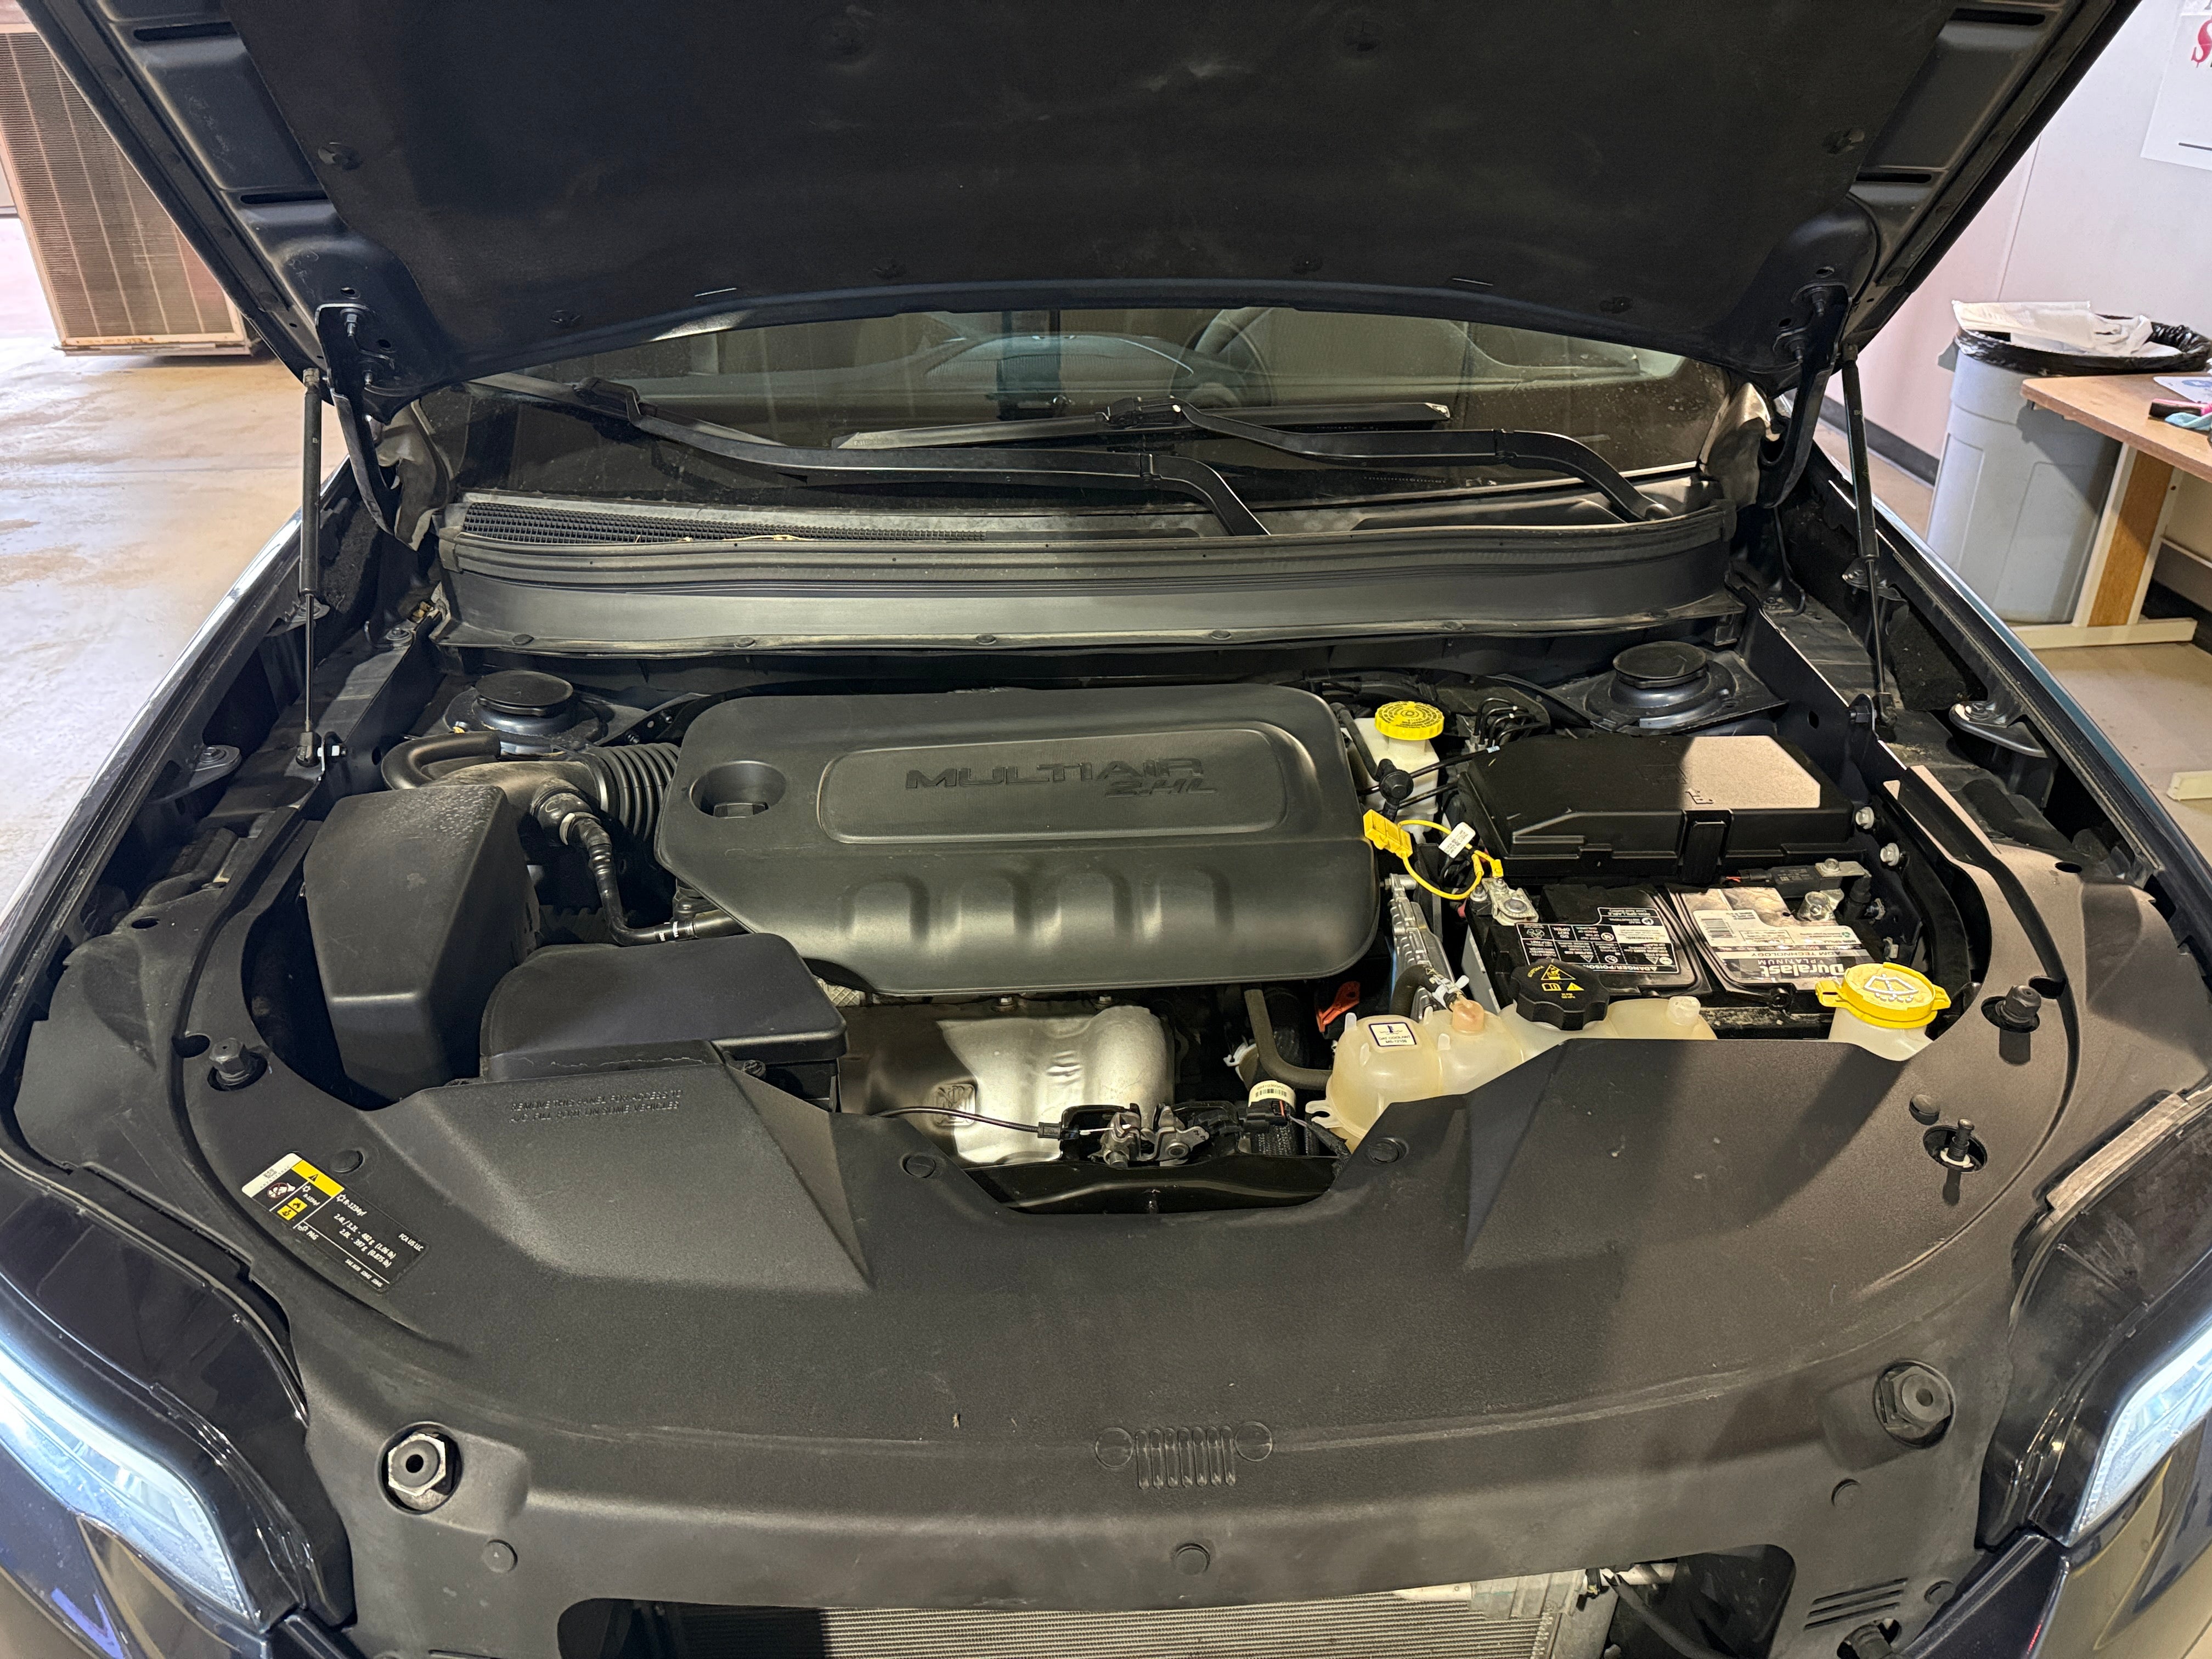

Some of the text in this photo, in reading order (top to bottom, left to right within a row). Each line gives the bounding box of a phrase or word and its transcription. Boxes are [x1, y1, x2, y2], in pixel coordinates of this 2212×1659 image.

[905, 758, 1205, 789] MULTIAIR
[1105, 777, 1217, 798] 2.4L
[1759, 963, 1844, 977] Duralast
[343, 1199, 367, 1216] R-1234yf
[398, 1233, 409, 1243] FCA
[414, 1243, 424, 1251] LLC
